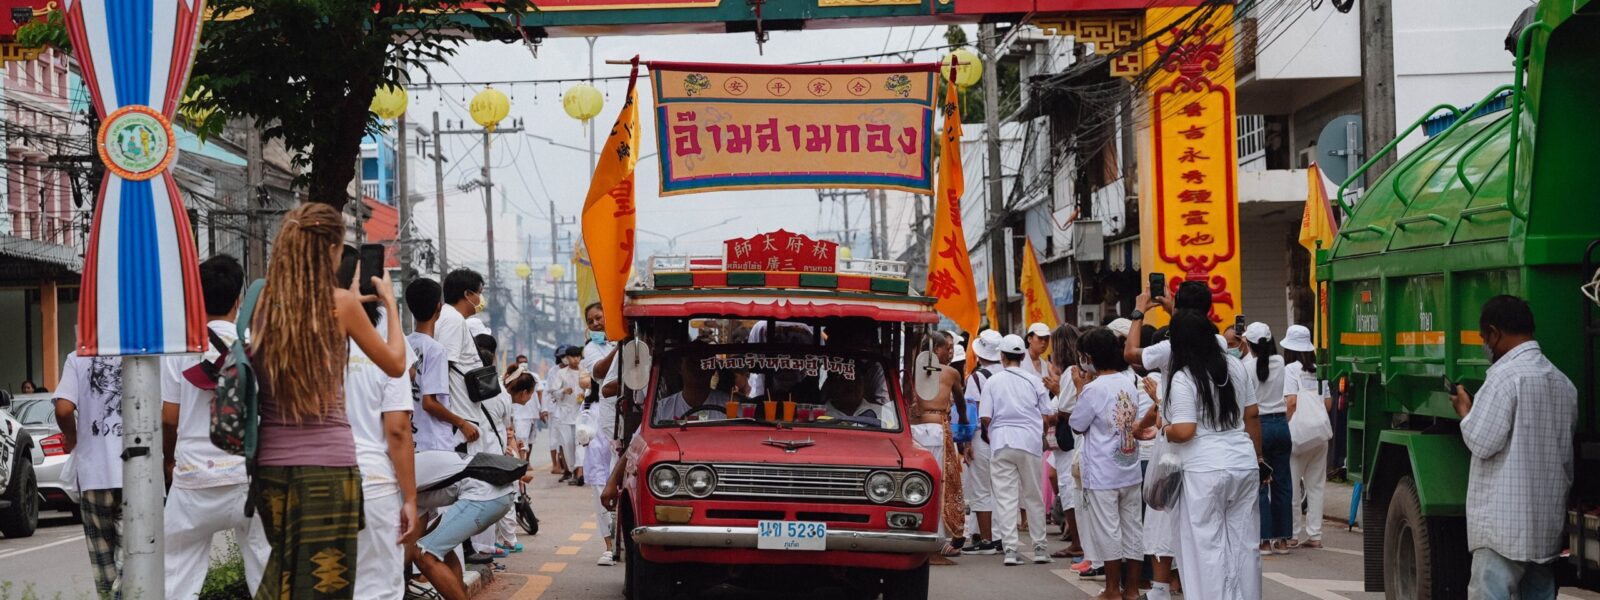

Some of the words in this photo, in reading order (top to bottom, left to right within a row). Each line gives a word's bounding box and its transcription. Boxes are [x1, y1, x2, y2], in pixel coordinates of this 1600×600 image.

[673, 111, 918, 157] อ๊ามสามกอง
[788, 522, 825, 538] 5236
